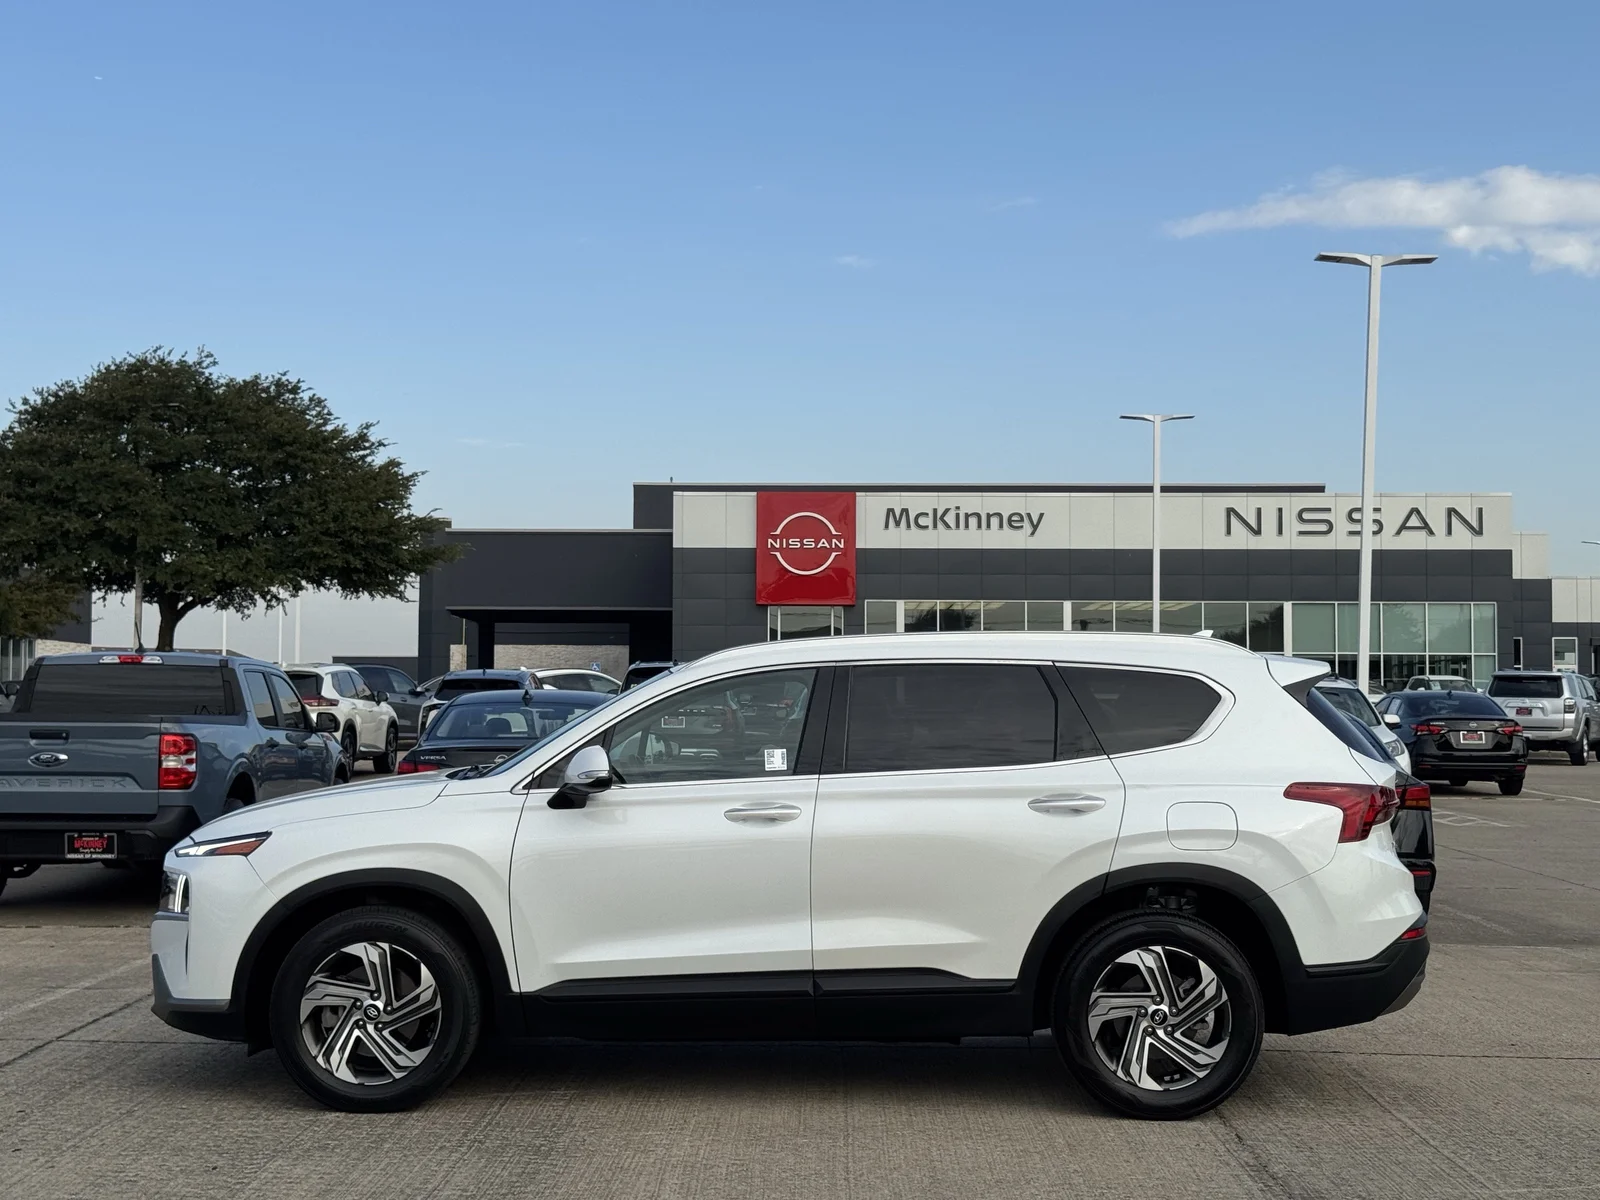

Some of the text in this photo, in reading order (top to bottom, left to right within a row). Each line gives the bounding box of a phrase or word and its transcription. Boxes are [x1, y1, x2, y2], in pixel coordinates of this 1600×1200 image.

[883, 506, 1045, 537] McKinney
[1225, 507, 1484, 537] NISSAN
[767, 538, 844, 549] NISSAN
